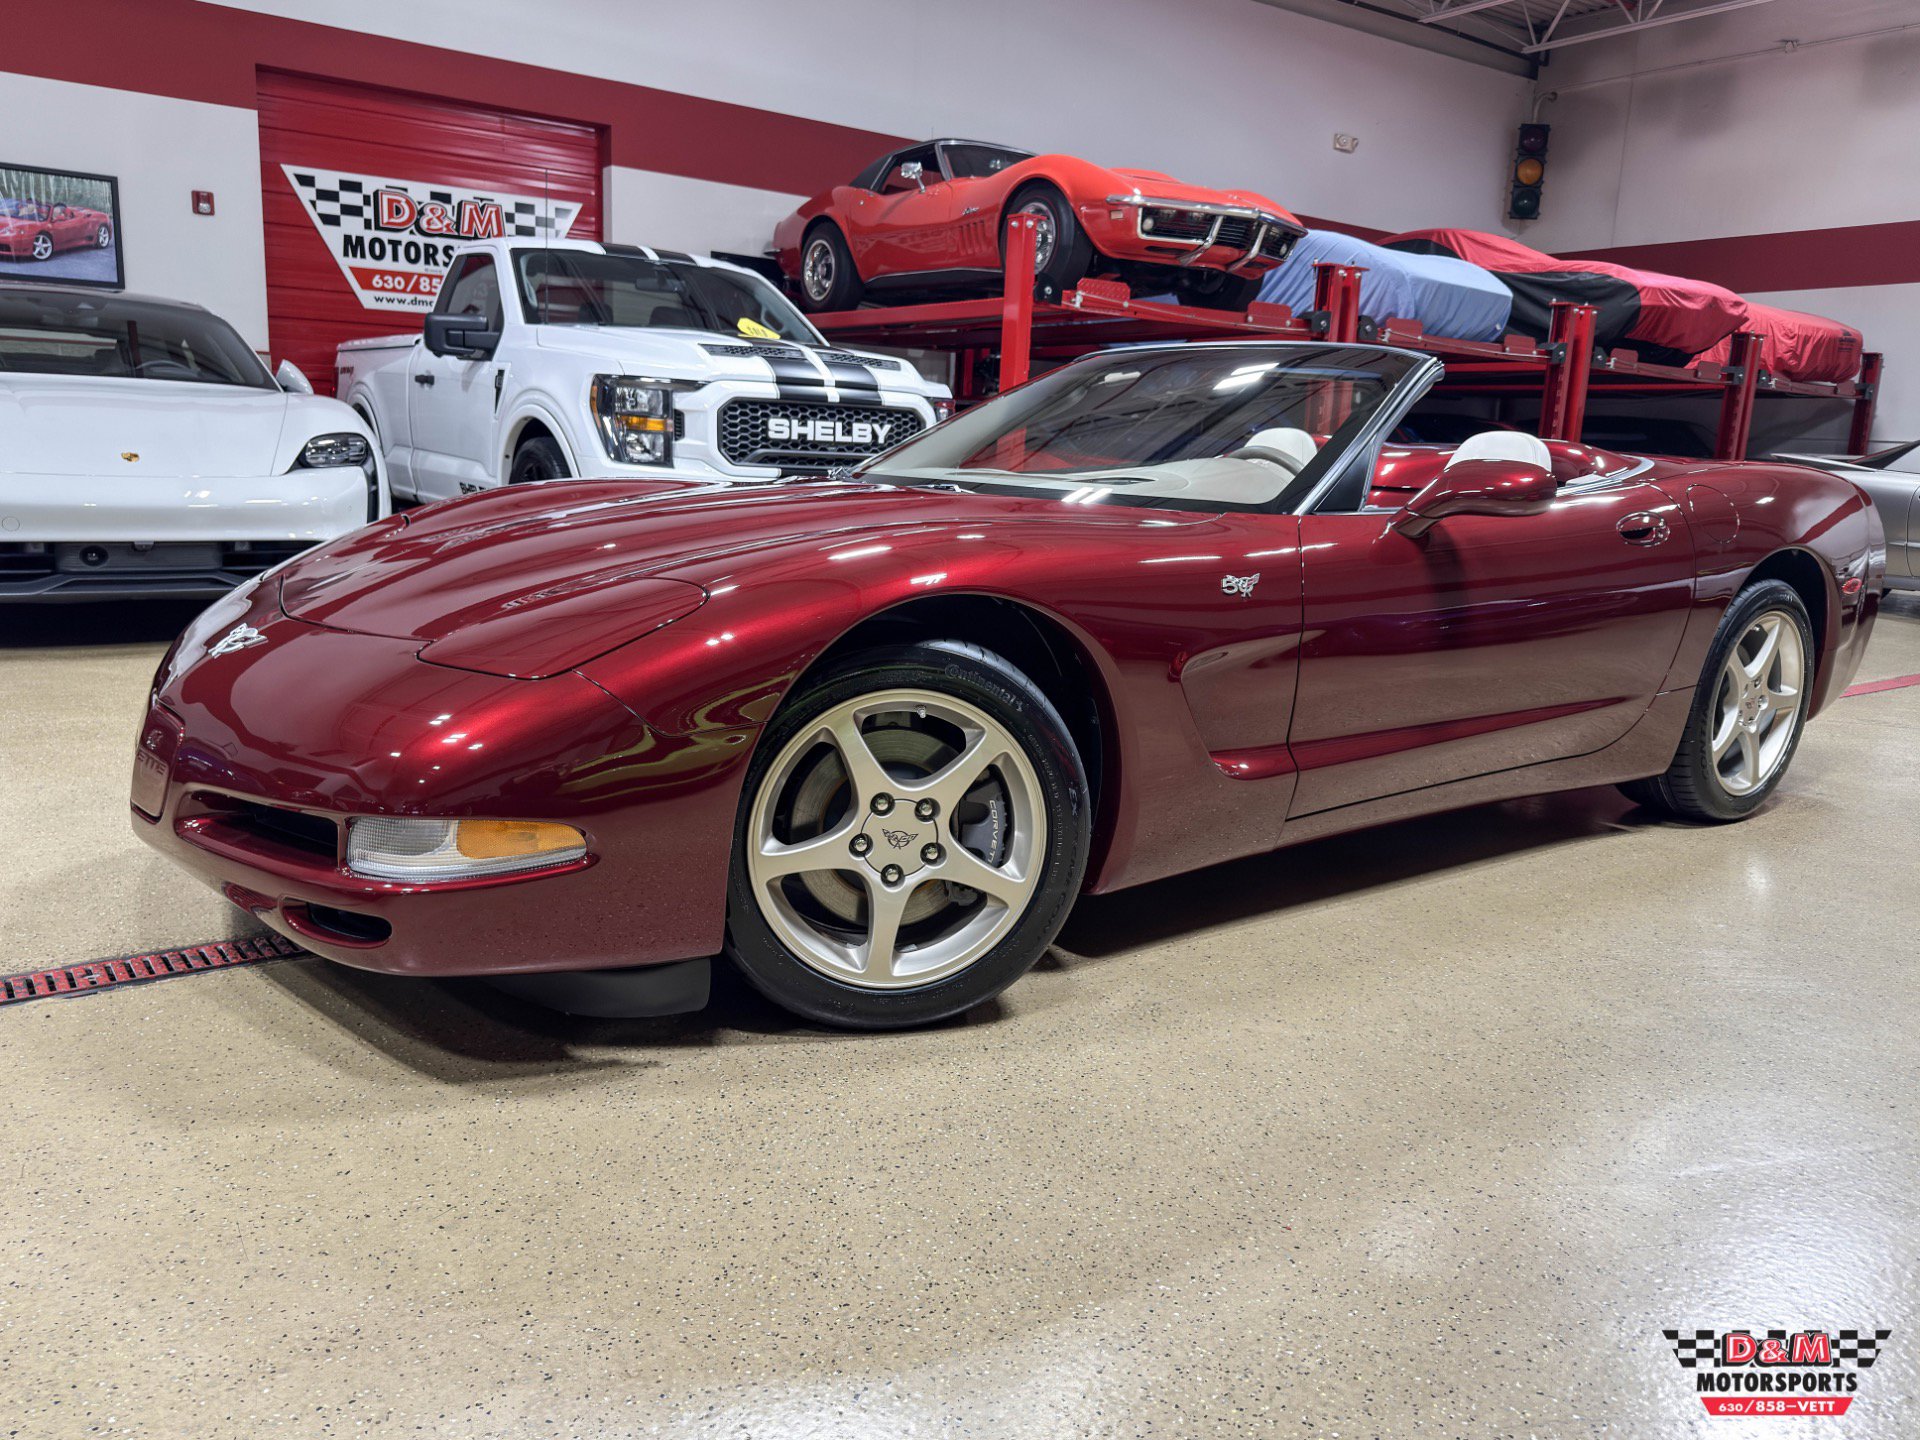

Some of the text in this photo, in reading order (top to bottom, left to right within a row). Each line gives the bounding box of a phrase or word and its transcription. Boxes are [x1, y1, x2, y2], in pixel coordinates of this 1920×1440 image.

[373, 189, 505, 240] D&M
[343, 234, 455, 268] MOTORS
[371, 273, 441, 293] 630/85
[767, 417, 892, 444] SHELBY
